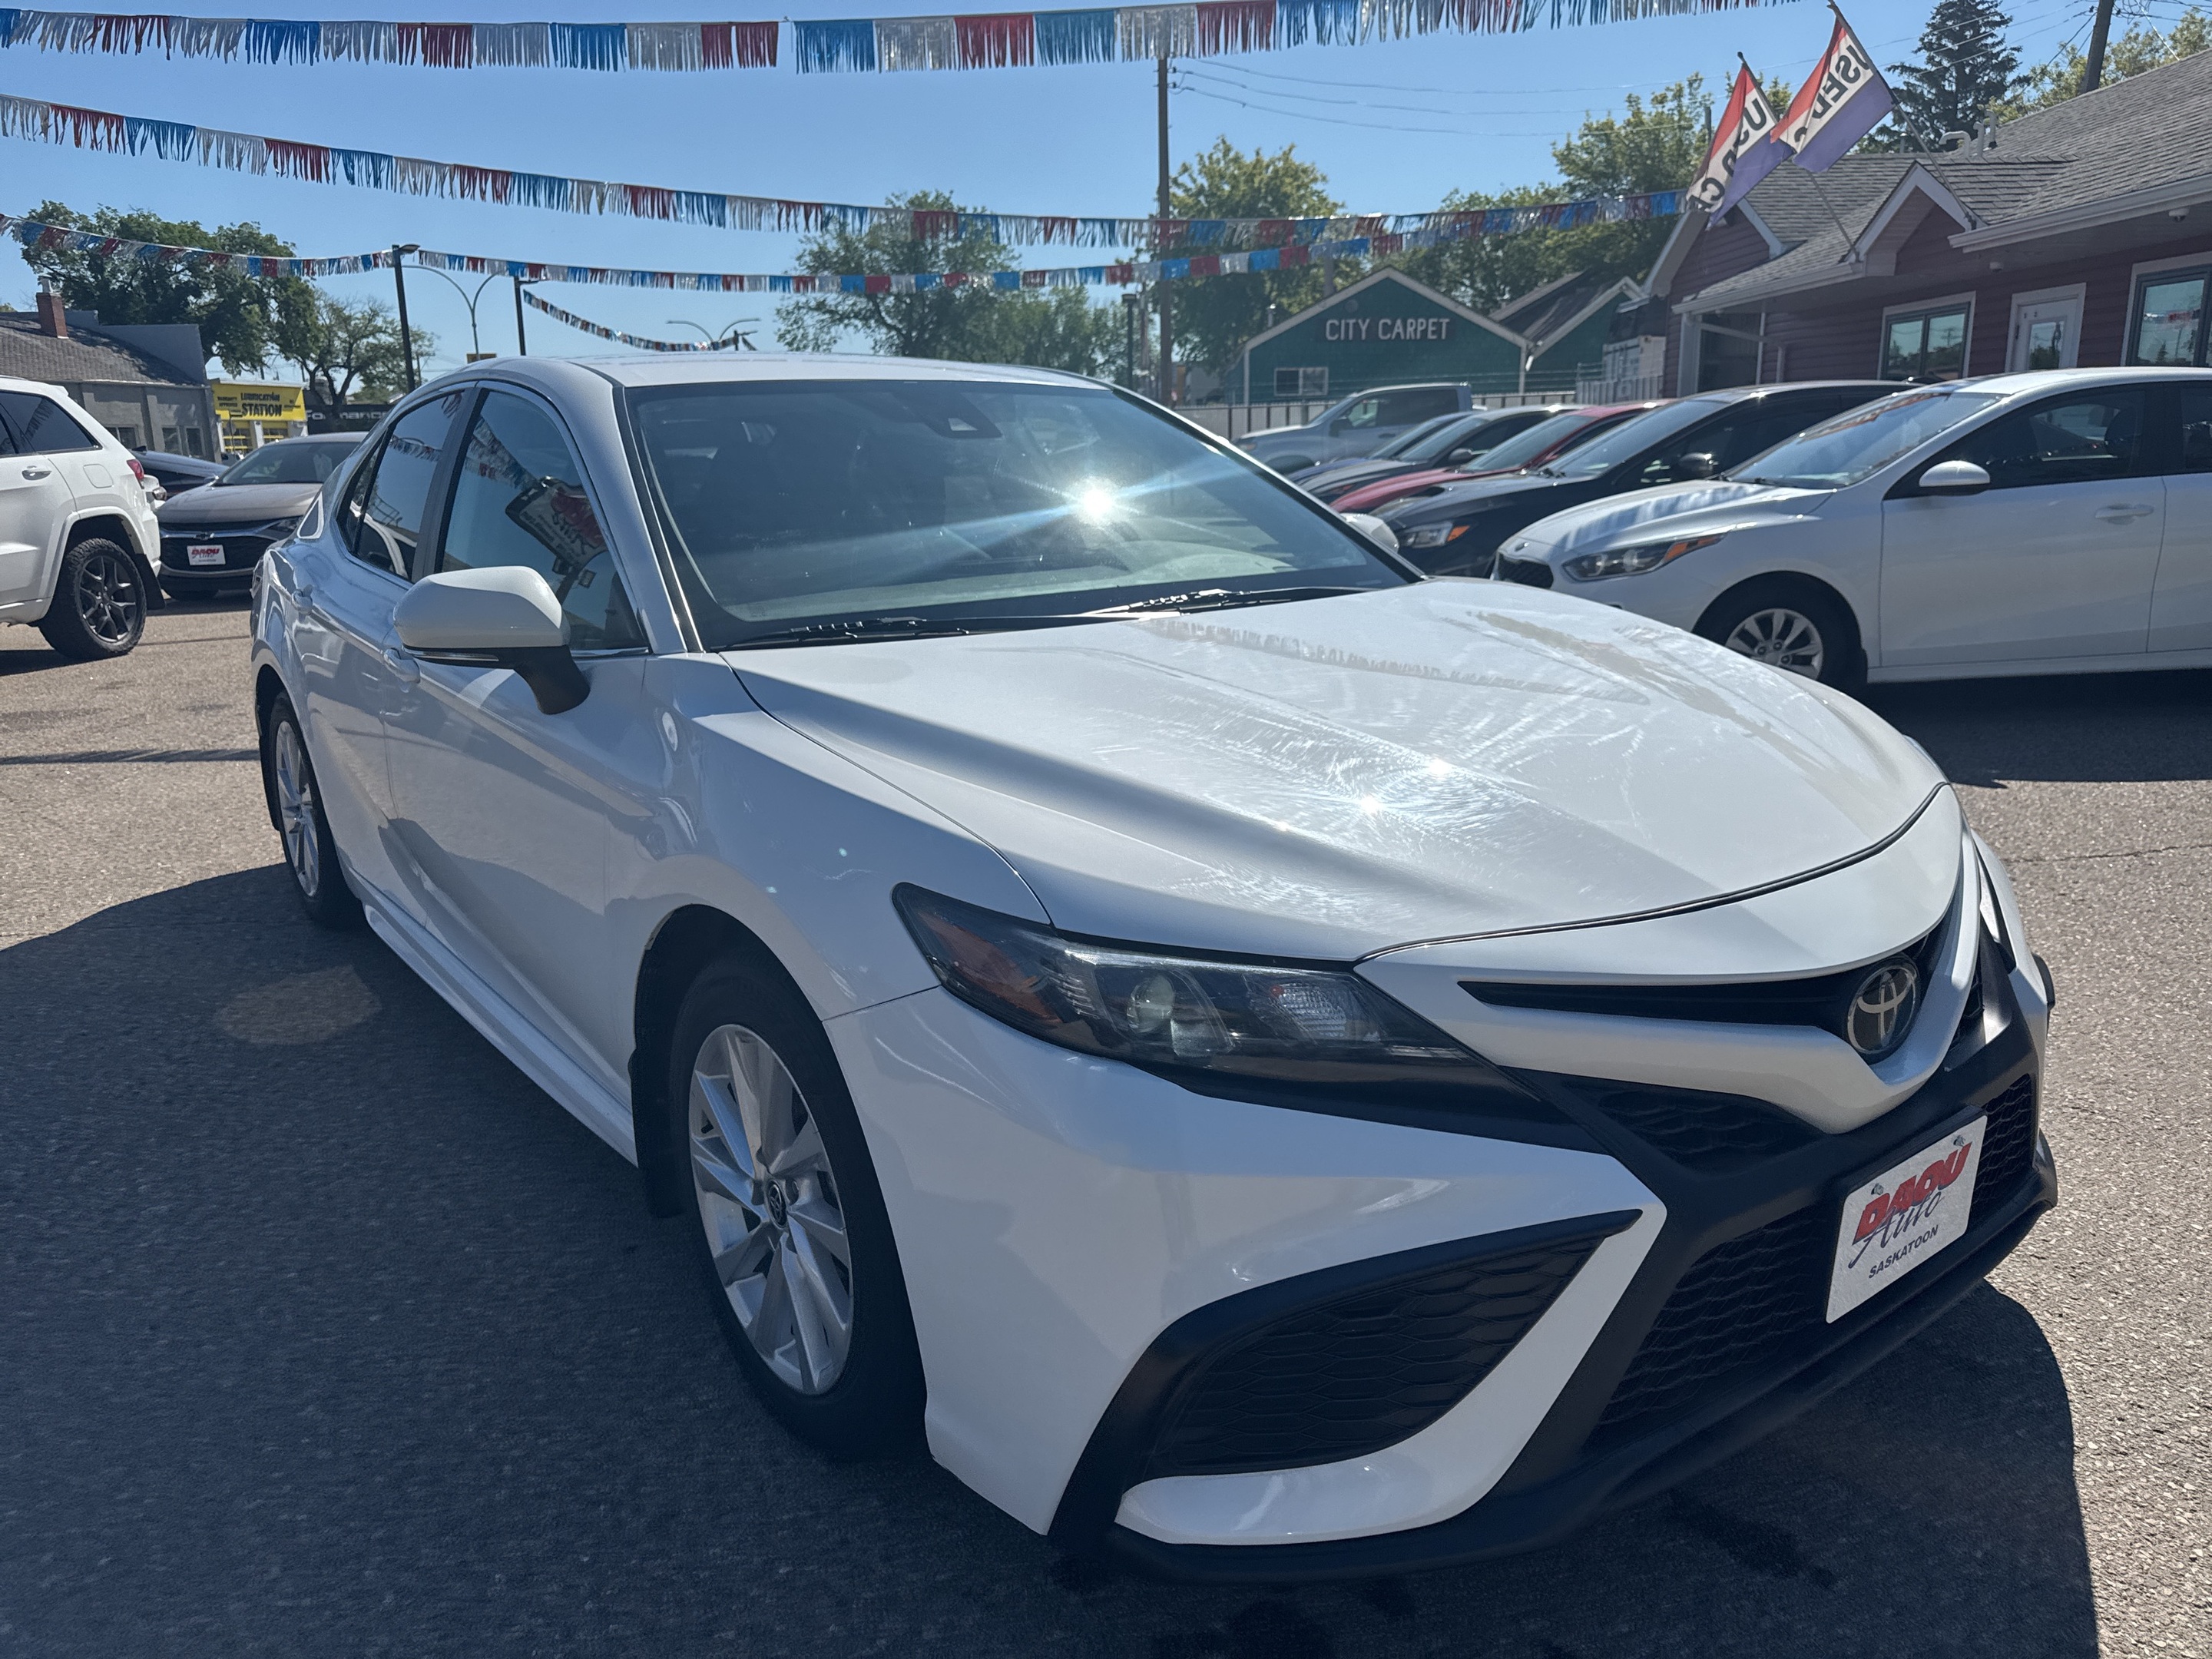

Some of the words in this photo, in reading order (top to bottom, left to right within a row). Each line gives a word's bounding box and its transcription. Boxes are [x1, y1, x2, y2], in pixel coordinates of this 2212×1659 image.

[1326, 319, 1370, 340] CITY
[1378, 318, 1450, 339] CARPET
[241, 403, 283, 416] STATION
[1852, 1141, 1972, 1245] DAOU
[1848, 1191, 1945, 1269] Auto
[1868, 1224, 1939, 1278] SASKATOON
